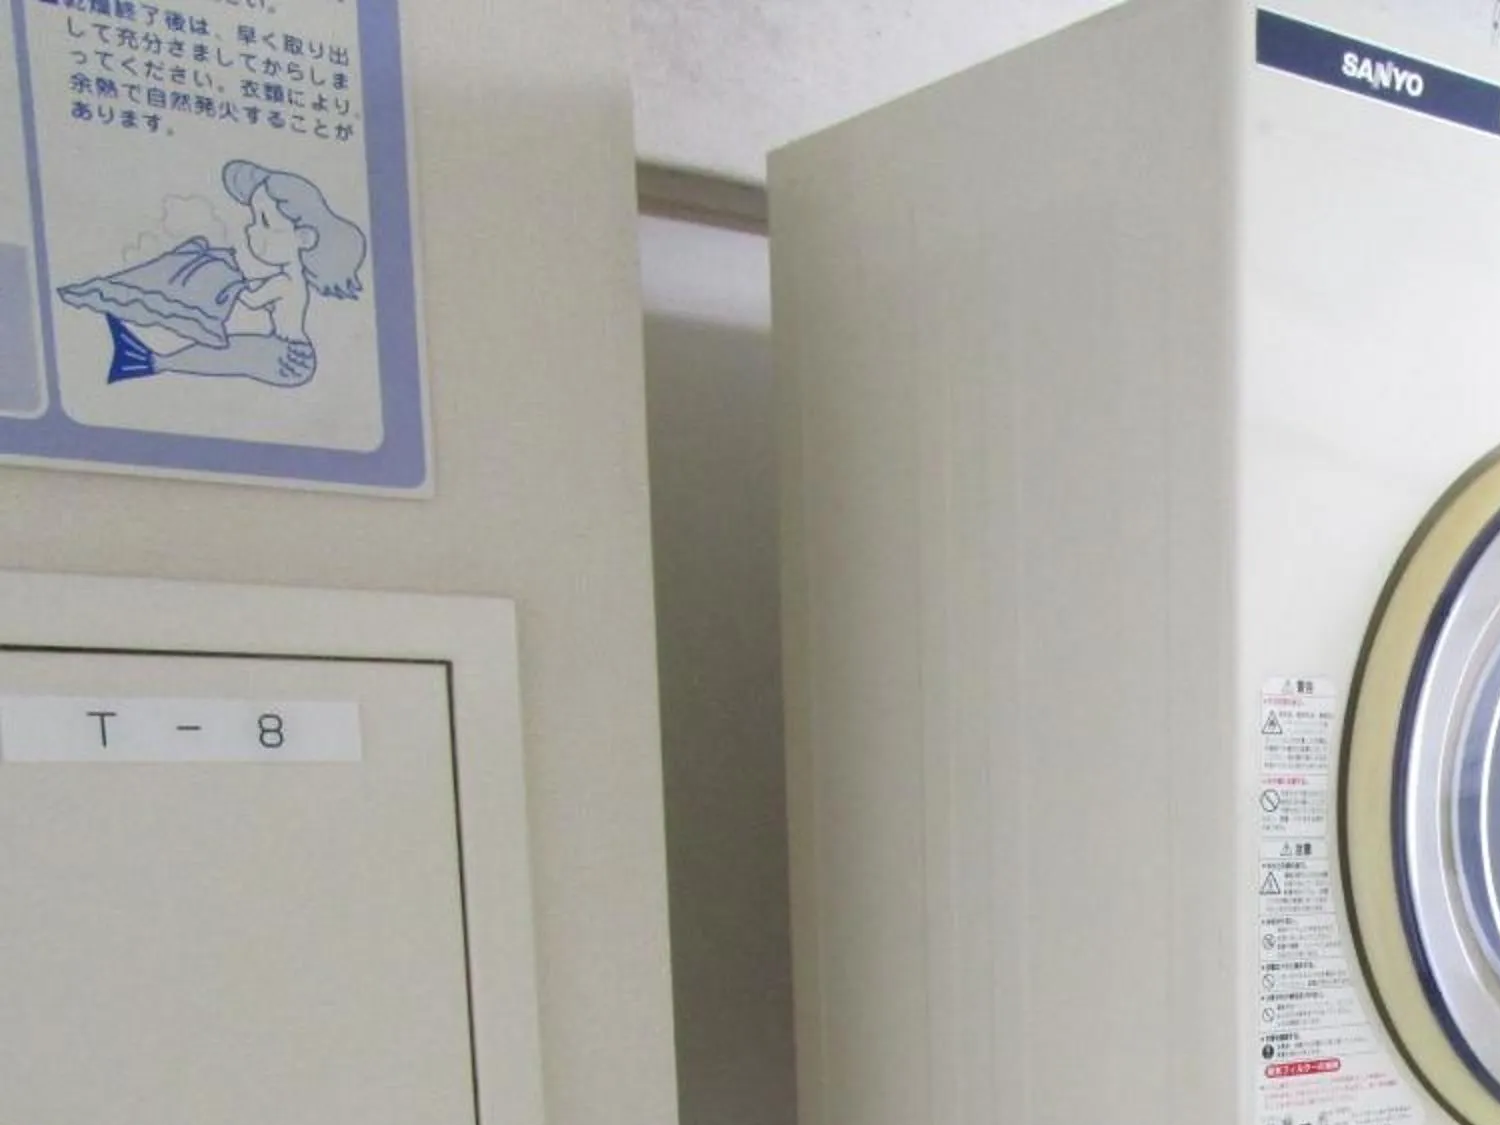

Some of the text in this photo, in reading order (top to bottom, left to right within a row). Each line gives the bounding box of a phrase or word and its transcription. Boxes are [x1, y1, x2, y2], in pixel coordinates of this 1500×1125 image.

[1342, 52, 1424, 98] SANYO
[70, 100, 175, 137] あります。
[86, 711, 118, 748] T
[258, 714, 284, 748] 8
